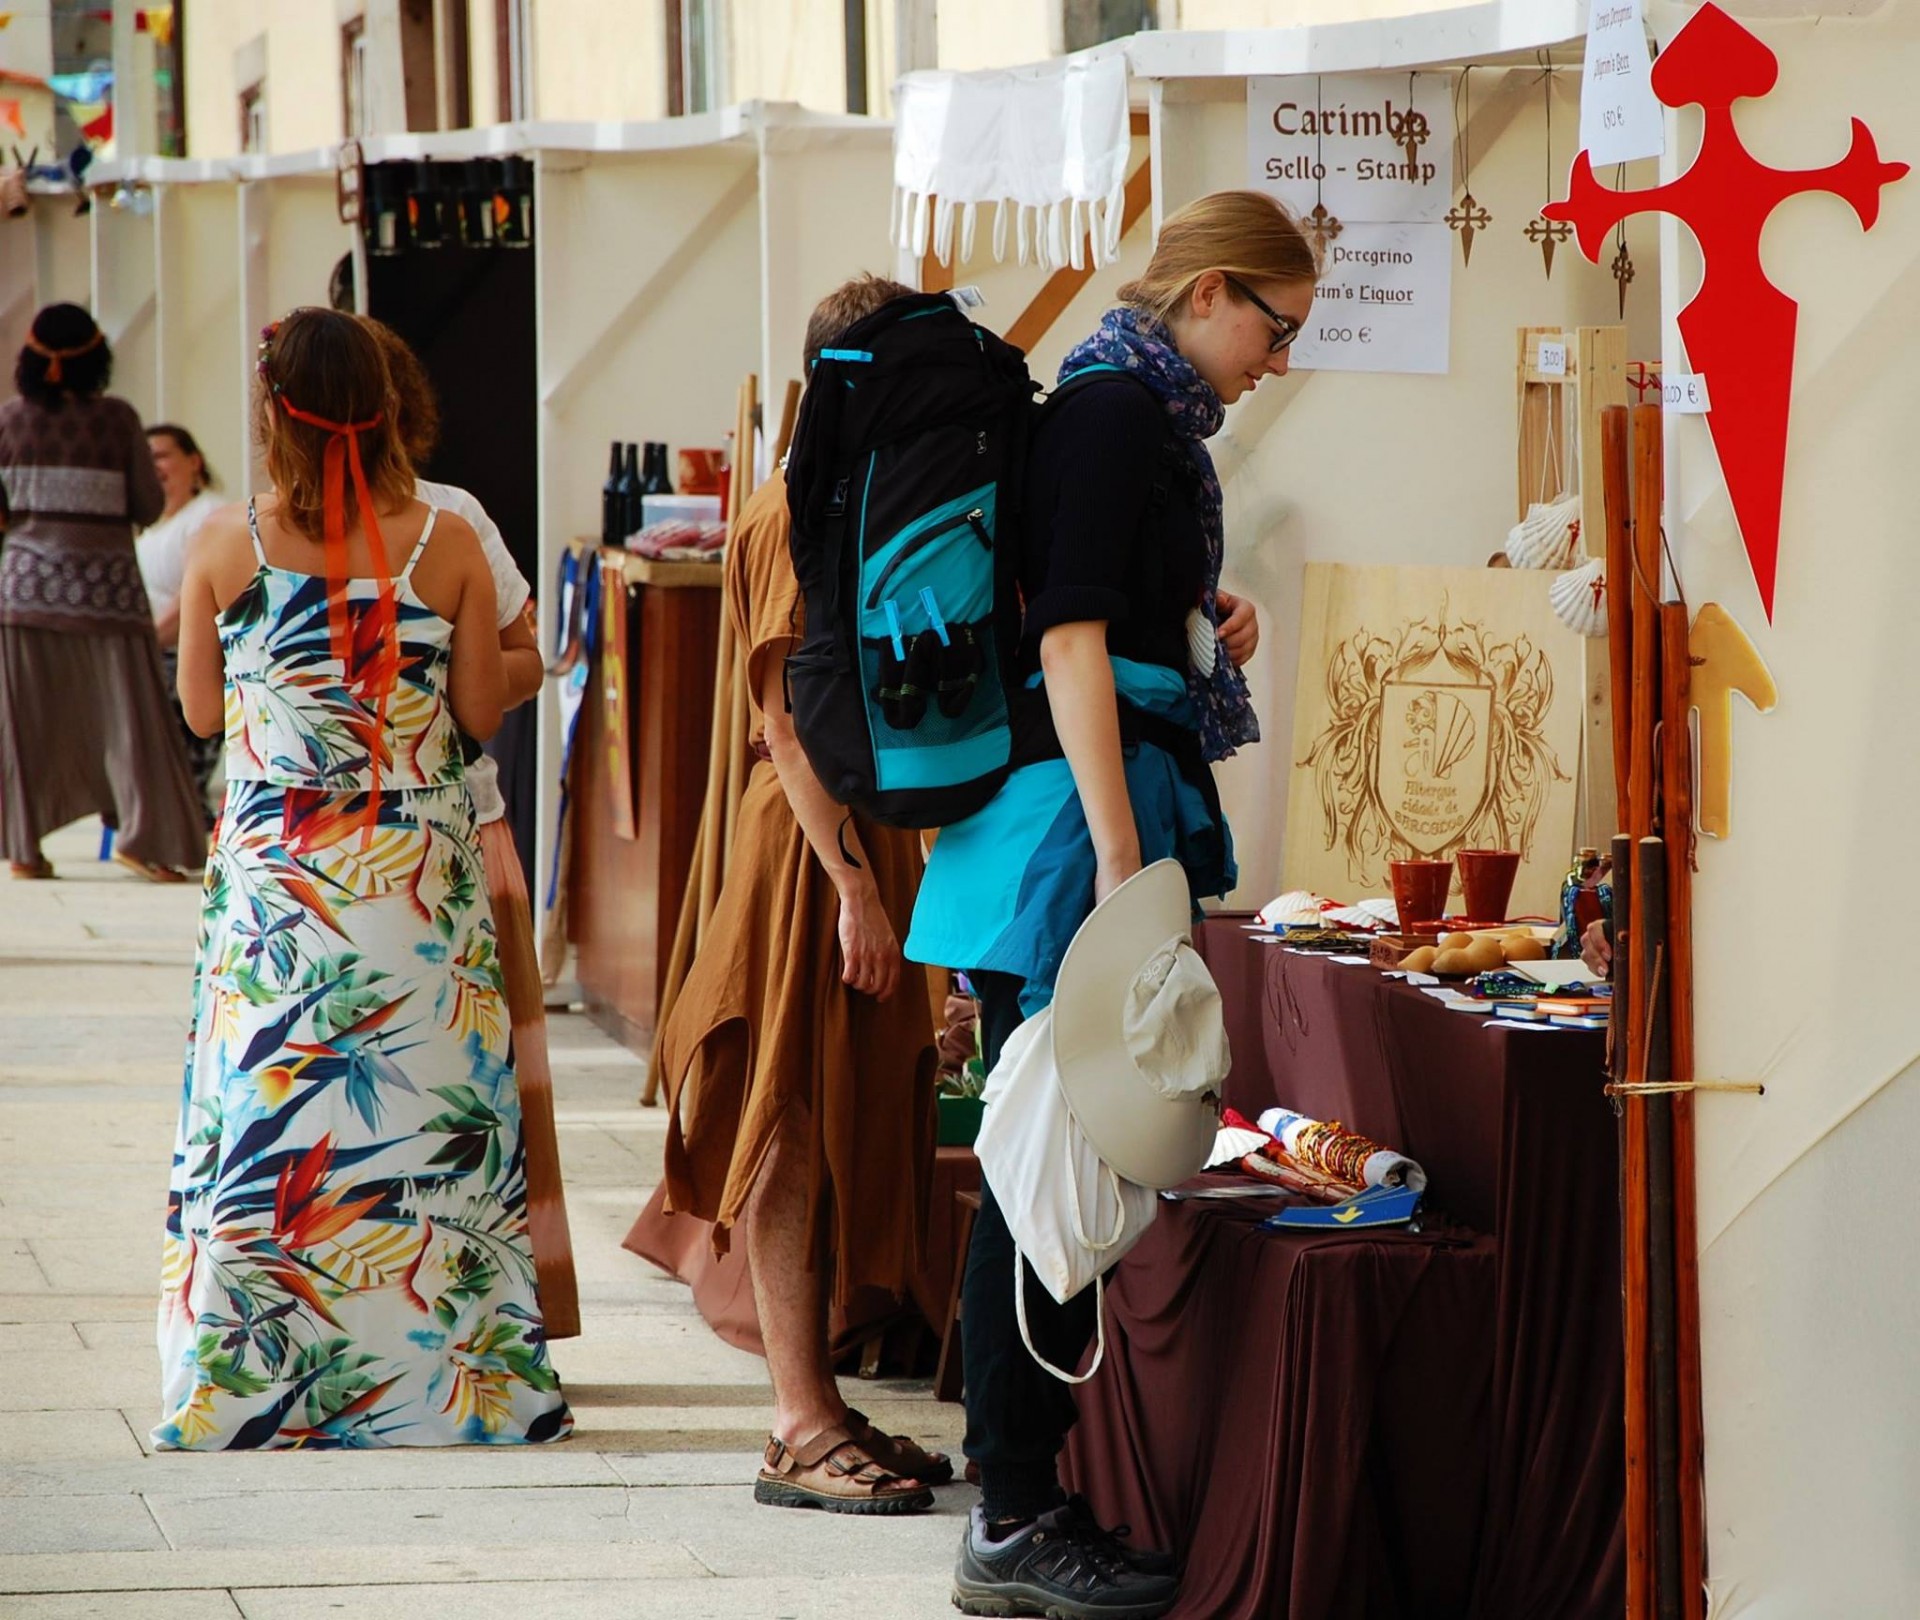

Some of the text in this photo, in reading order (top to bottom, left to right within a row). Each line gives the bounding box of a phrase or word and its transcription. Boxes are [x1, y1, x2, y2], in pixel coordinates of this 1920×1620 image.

[1273, 100, 1428, 137] Carimbo
[1265, 156, 1326, 180] Sello
[1356, 157, 1436, 186] Stamp
[1333, 246, 1413, 267] Peregrino
[1314, 283, 1414, 305] rim's Liquor
[1358, 326, 1372, 344] €
[1687, 381, 1699, 405] €
